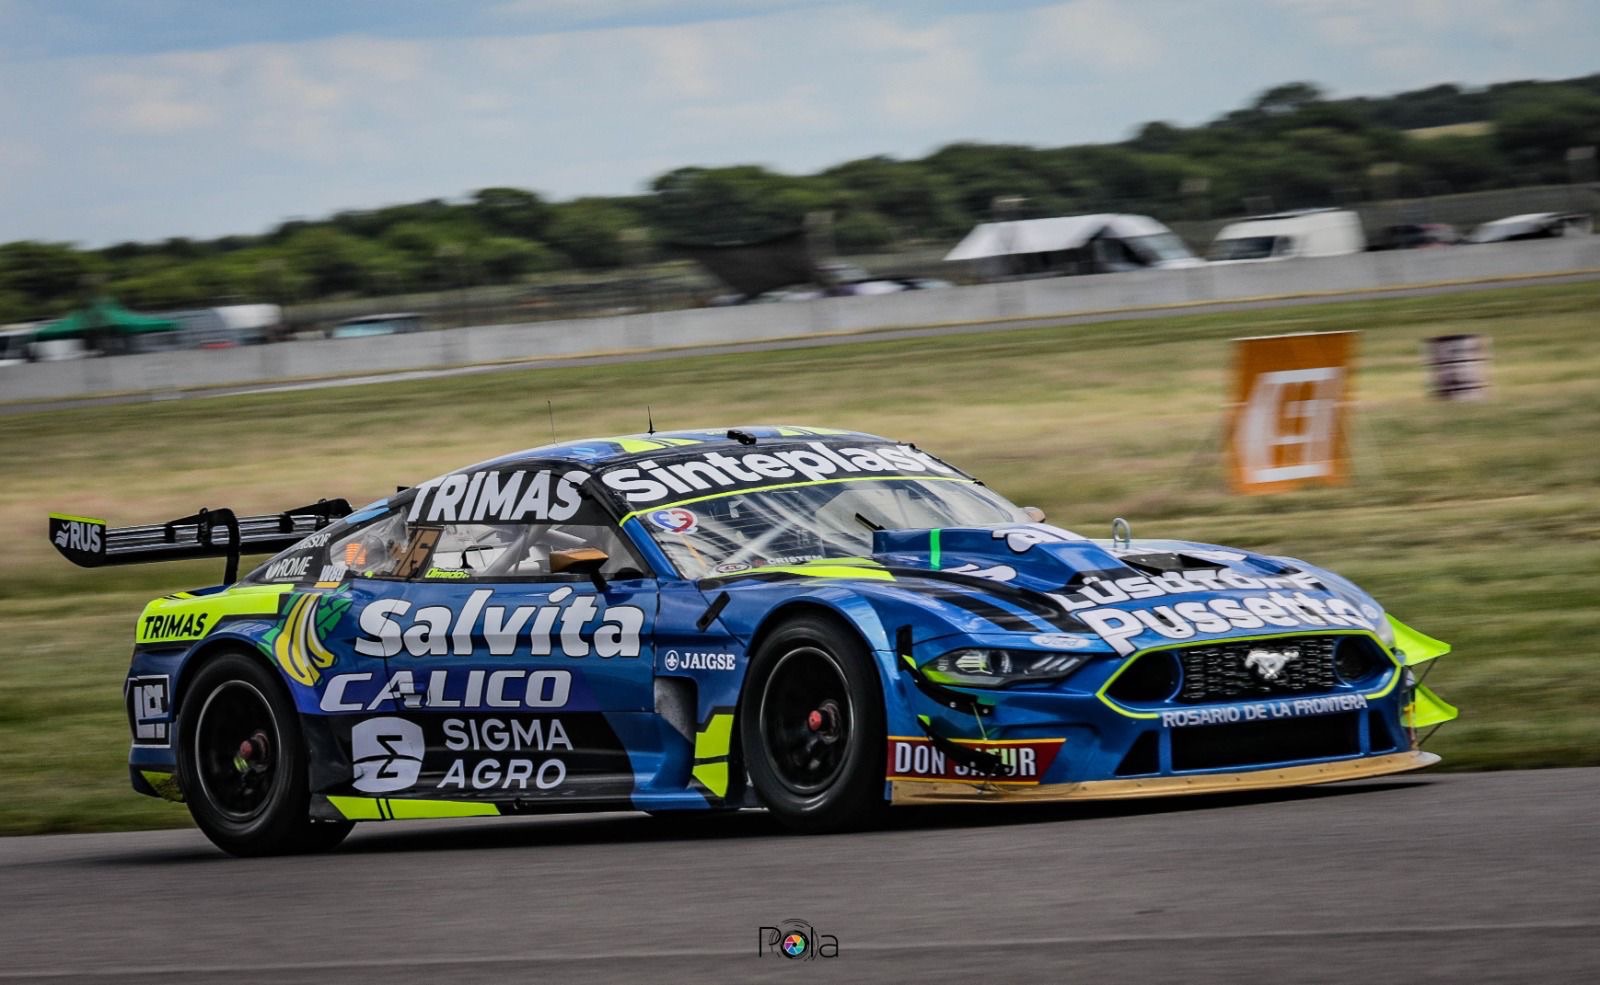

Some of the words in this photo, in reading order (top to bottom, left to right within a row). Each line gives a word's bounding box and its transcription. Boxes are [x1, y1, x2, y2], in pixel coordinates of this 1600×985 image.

[408, 470, 589, 522] TRIMAS
[275, 556, 314, 577] ROME
[142, 612, 209, 640] TRIMAS
[680, 652, 736, 671] JAIGSE
[318, 669, 572, 712] CALICO
[1162, 709, 1241, 728] ROSARIO
[1244, 704, 1268, 721] DE
[1270, 702, 1291, 718] LA
[1294, 694, 1368, 716] FRONTERA
[442, 717, 574, 752] SIGMA
[436, 758, 567, 791] AGRO
[894, 741, 946, 776] DON
